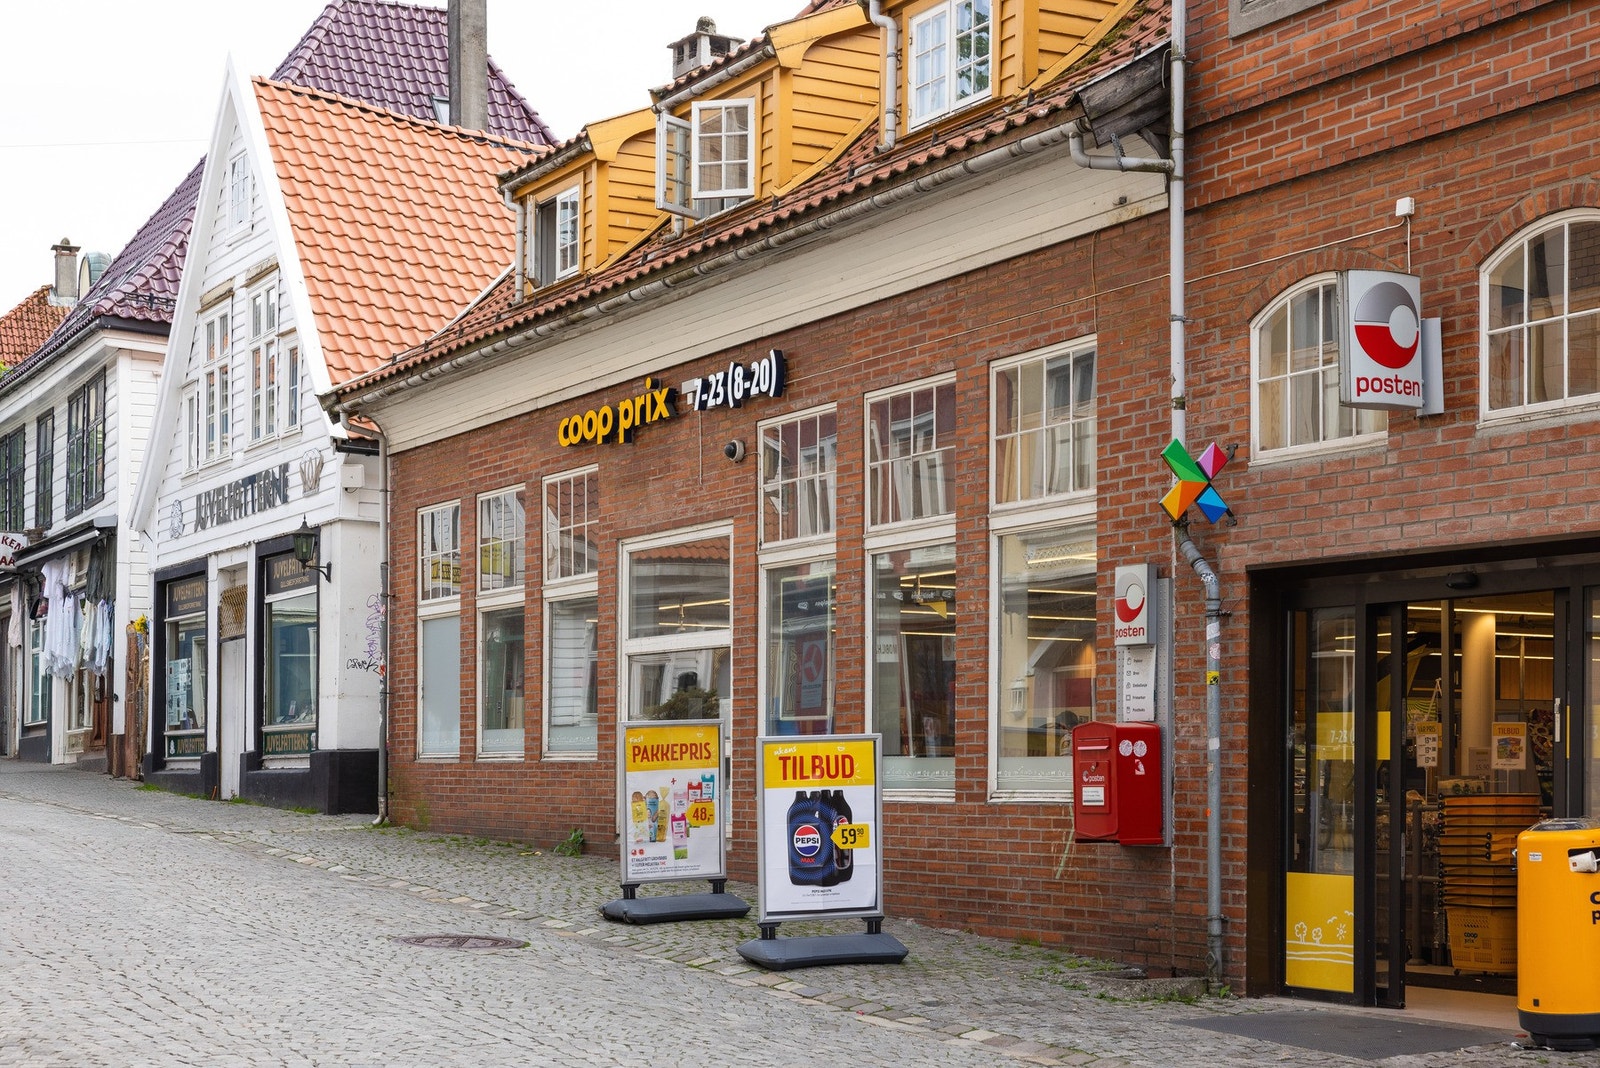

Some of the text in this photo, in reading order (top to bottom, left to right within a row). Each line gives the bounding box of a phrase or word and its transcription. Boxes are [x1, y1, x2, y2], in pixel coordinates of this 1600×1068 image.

[1356, 374, 1420, 397] posten
[558, 349, 777, 447] coop prix 7-23 (8-20)
[194, 462, 290, 533] JUVELFATTERNE
[1497, 727, 1520, 735] TILBUD
[632, 741, 712, 764] PAKKEPRIS
[778, 754, 855, 781] TILBUD
[795, 837, 820, 845] PEPSI
[841, 828, 857, 845] 59
